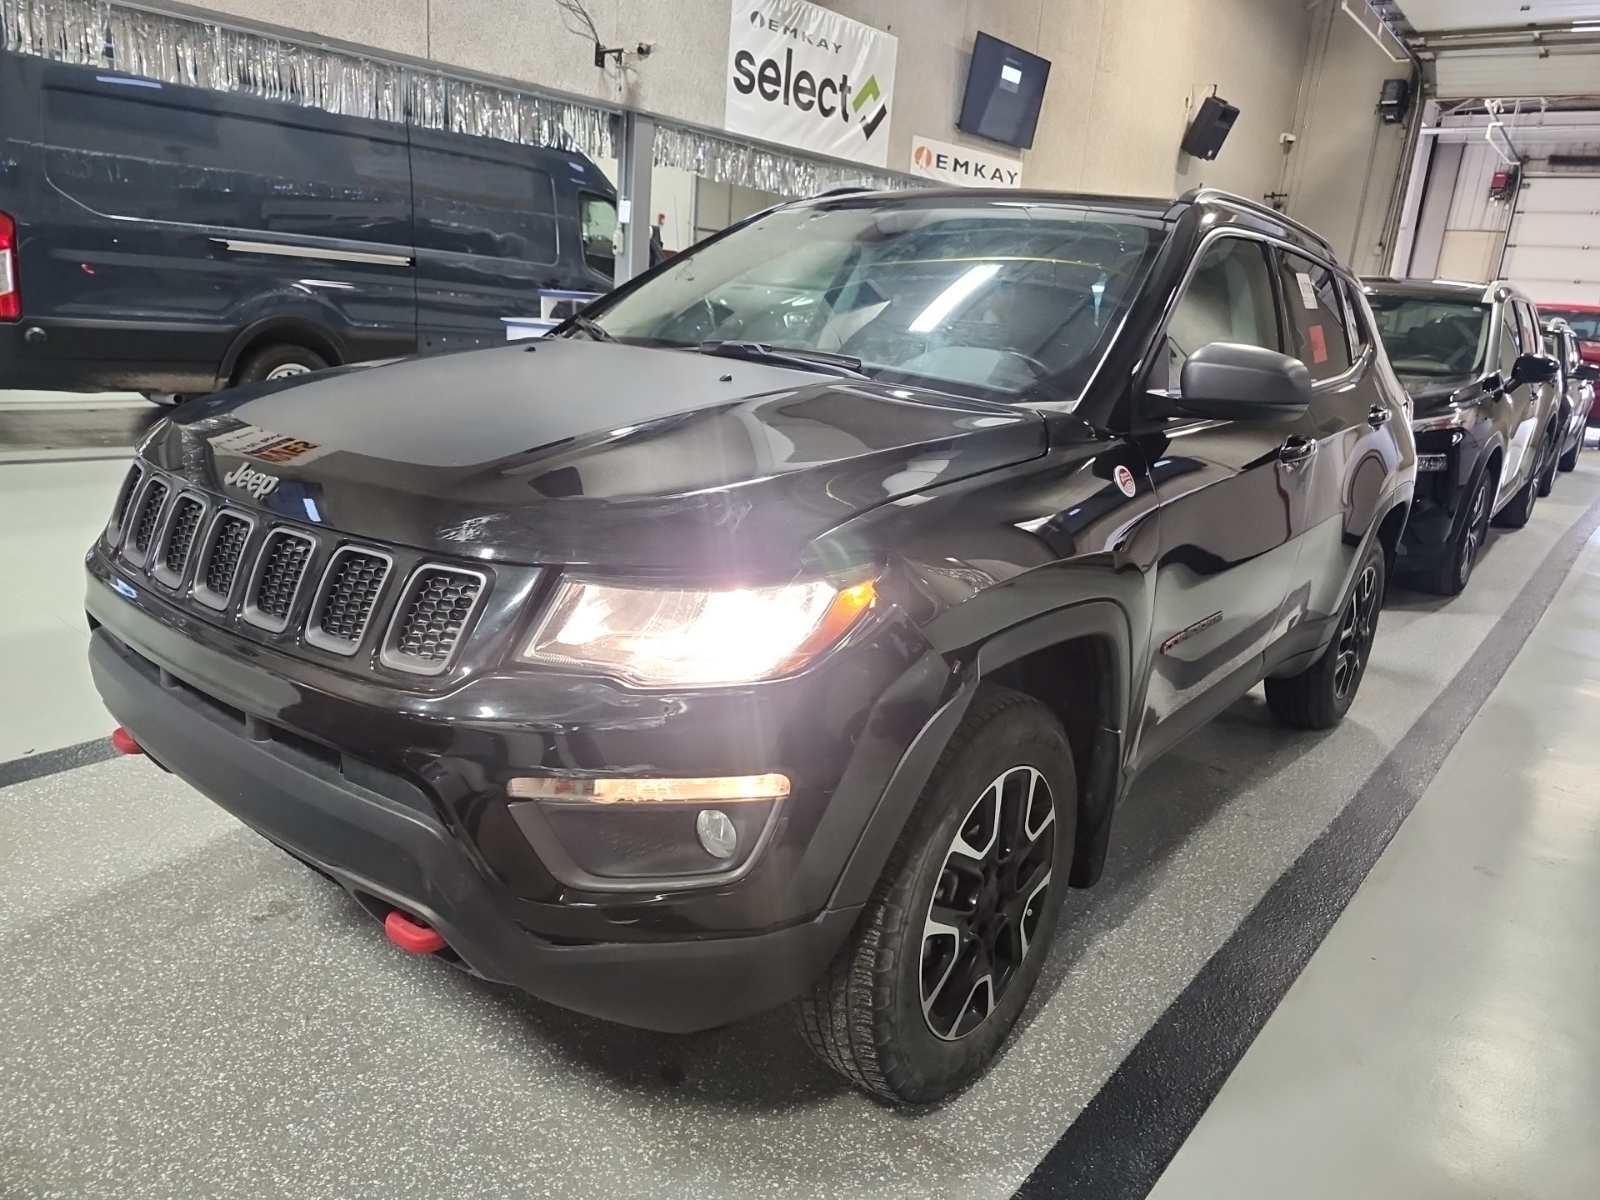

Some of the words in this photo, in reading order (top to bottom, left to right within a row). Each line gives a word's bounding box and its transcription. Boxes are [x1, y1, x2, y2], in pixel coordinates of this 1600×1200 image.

[768, 18, 842, 54] EMKAY
[733, 47, 852, 123] select
[935, 153, 1019, 185] EMKAY
[224, 461, 280, 499] Jeep
